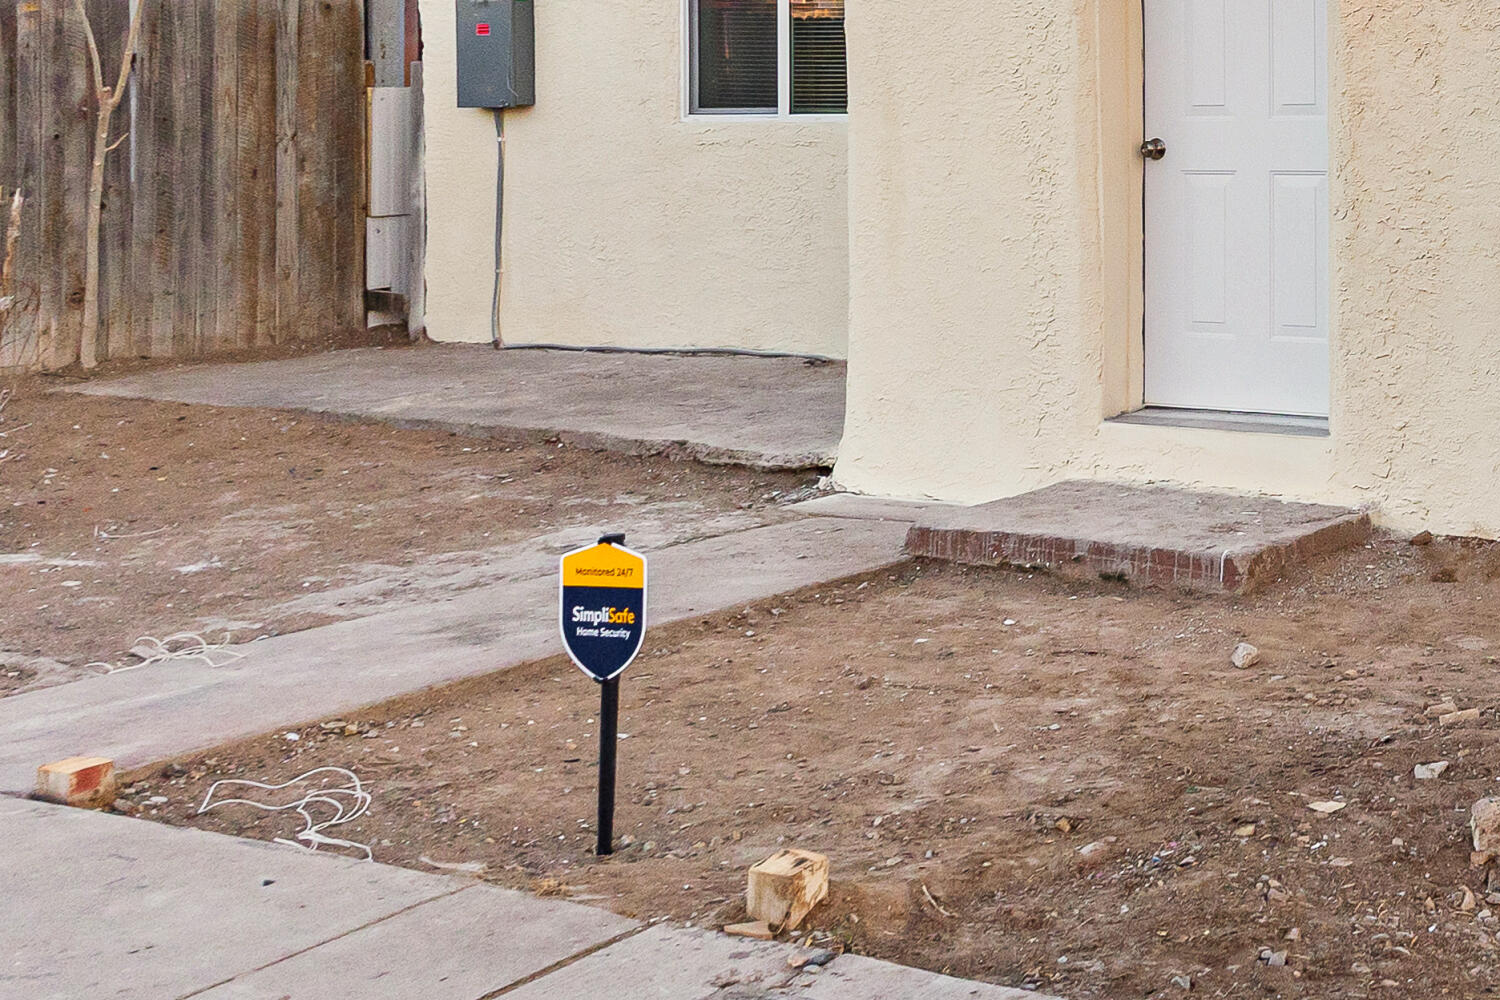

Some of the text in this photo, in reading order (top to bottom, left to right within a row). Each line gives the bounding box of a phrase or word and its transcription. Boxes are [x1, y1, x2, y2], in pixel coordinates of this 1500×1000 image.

[575, 567, 634, 577] Monitored 24/7
[572, 605, 635, 626] SimpliSafe
[576, 627, 631, 640] Home Security
